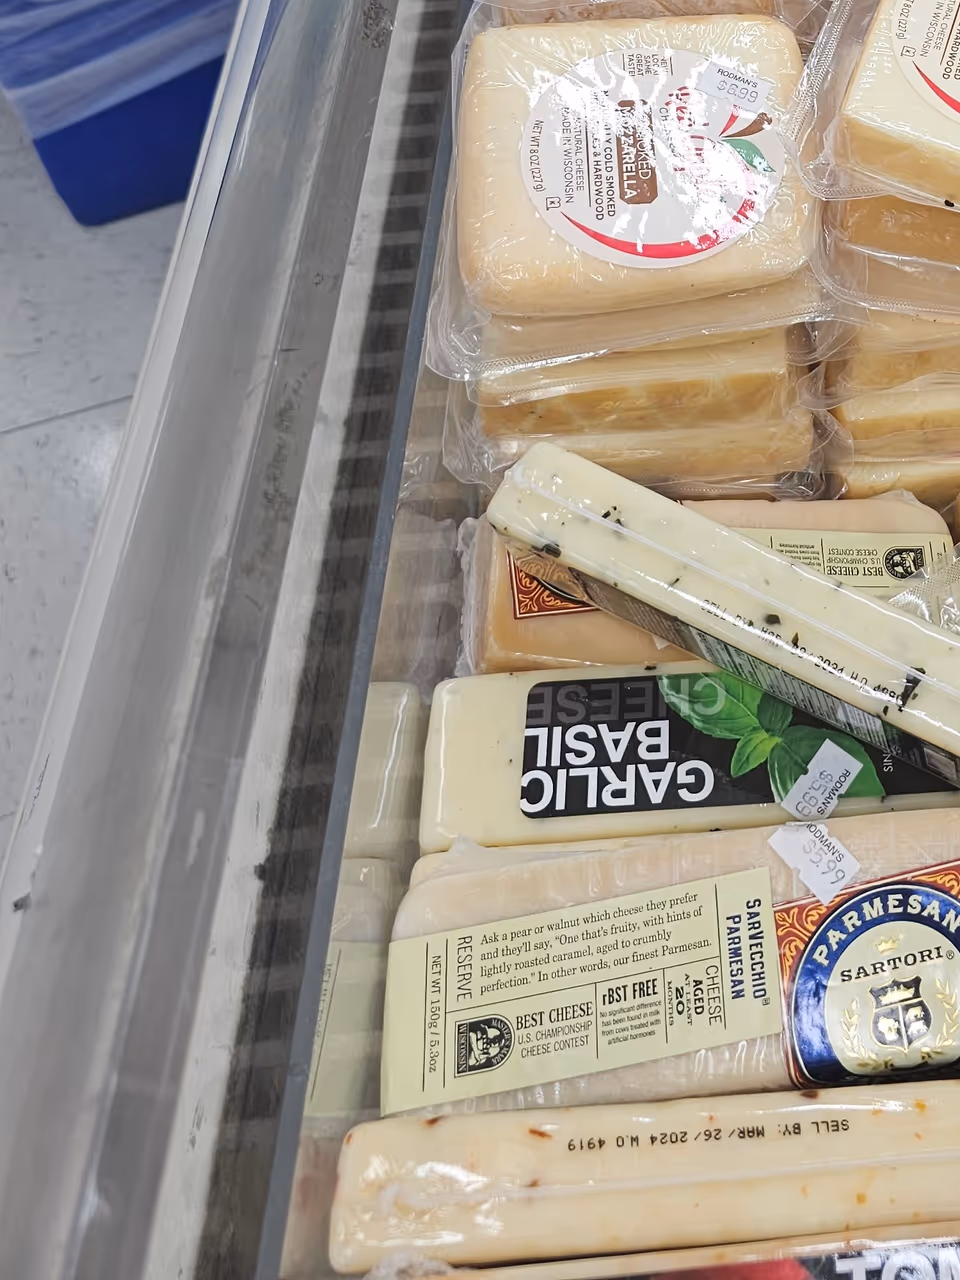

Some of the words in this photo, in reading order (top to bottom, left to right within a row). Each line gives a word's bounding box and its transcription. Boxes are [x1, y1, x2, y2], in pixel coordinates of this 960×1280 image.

[920, 12, 940, 57] WISCONSIN
[934, 22, 948, 50] CHEESE
[716, 68, 758, 89] RODMAN'S
[716, 80, 759, 103] $6.99
[563, 149, 575, 203] WISCONSIN
[593, 161, 605, 220] HARDWOOD
[605, 174, 616, 217] SMOKED
[826, 565, 858, 576] CHEESE
[862, 566, 884, 576] BEST
[526, 678, 723, 725] CHEESE
[524, 719, 670, 767] BASIL
[520, 759, 715, 814] GARLIC
[816, 768, 851, 816] RODMAN'S
[802, 838, 846, 884] $5.99
[480, 933, 500, 946] Ask
[510, 927, 533, 944] pear
[546, 918, 581, 933] walnut
[582, 909, 611, 925] which
[613, 902, 644, 919] cheese
[646, 898, 672, 916] they
[669, 893, 698, 909] prefer
[480, 950, 500, 961] and
[642, 915, 665, 928] with
[666, 911, 691, 923] hints
[431, 955, 441, 976] NET
[480, 962, 513, 979] lightly
[514, 954, 550, 969] roasted
[552, 945, 594, 963] caramel,
[596, 941, 619, 955] aged
[632, 929, 672, 947] crumbly
[551, 967, 577, 981] other
[613, 956, 631, 967] our
[632, 947, 658, 963] finest
[661, 938, 713, 957] Parmesan.
[726, 914, 745, 1000] PARMESAN
[746, 898, 767, 1000] SARVECCHIO
[840, 945, 944, 983] SARTORI
[431, 978, 441, 994] WT
[456, 935, 473, 1003] RESERVE
[602, 984, 629, 1006] rBST
[633, 978, 658, 1000] FREE
[675, 986, 685, 1015] 20
[693, 979, 705, 1015] AGED
[705, 965, 722, 1026] CHEESE
[428, 1000, 440, 1029] 150g
[515, 1015, 546, 1031] BEST
[549, 1001, 594, 1023] CHEESE
[535, 1021, 594, 1042] CHAMPIONSHIP
[428, 1040, 439, 1073] 5.3oz
[521, 1044, 553, 1059] CHEESE
[553, 1035, 590, 1052] CONTEST
[649, 1130, 689, 1146] 2024
[810, 1118, 850, 1134] SELL
